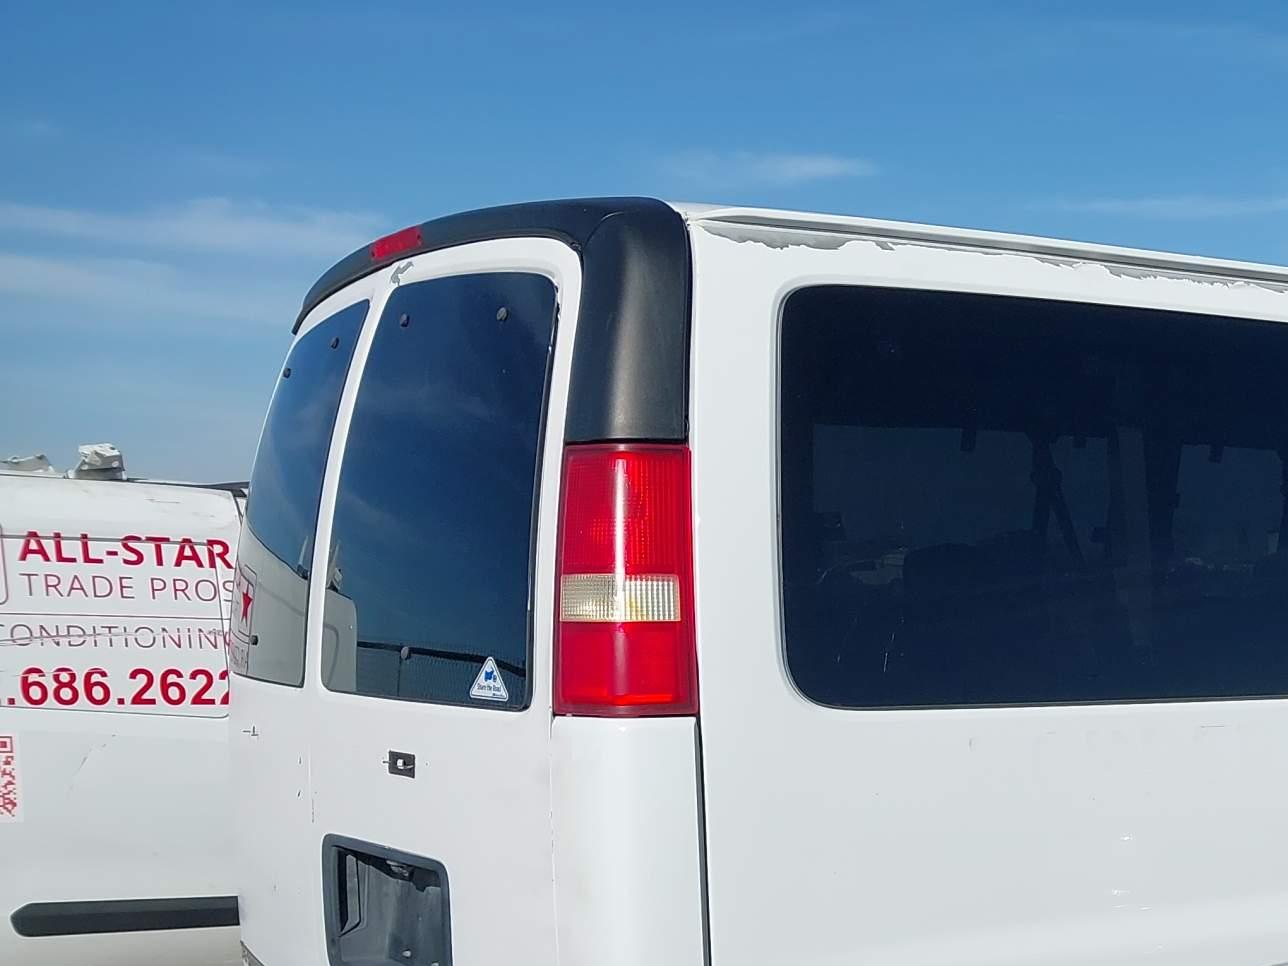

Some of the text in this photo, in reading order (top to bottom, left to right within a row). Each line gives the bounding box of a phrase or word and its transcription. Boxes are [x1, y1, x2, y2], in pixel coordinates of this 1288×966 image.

[18, 531, 234, 569] ALL-STAR
[19, 572, 136, 600] TRADE
[0, 622, 232, 651] ONDITIONIN
[0, 666, 230, 706] .686.262
